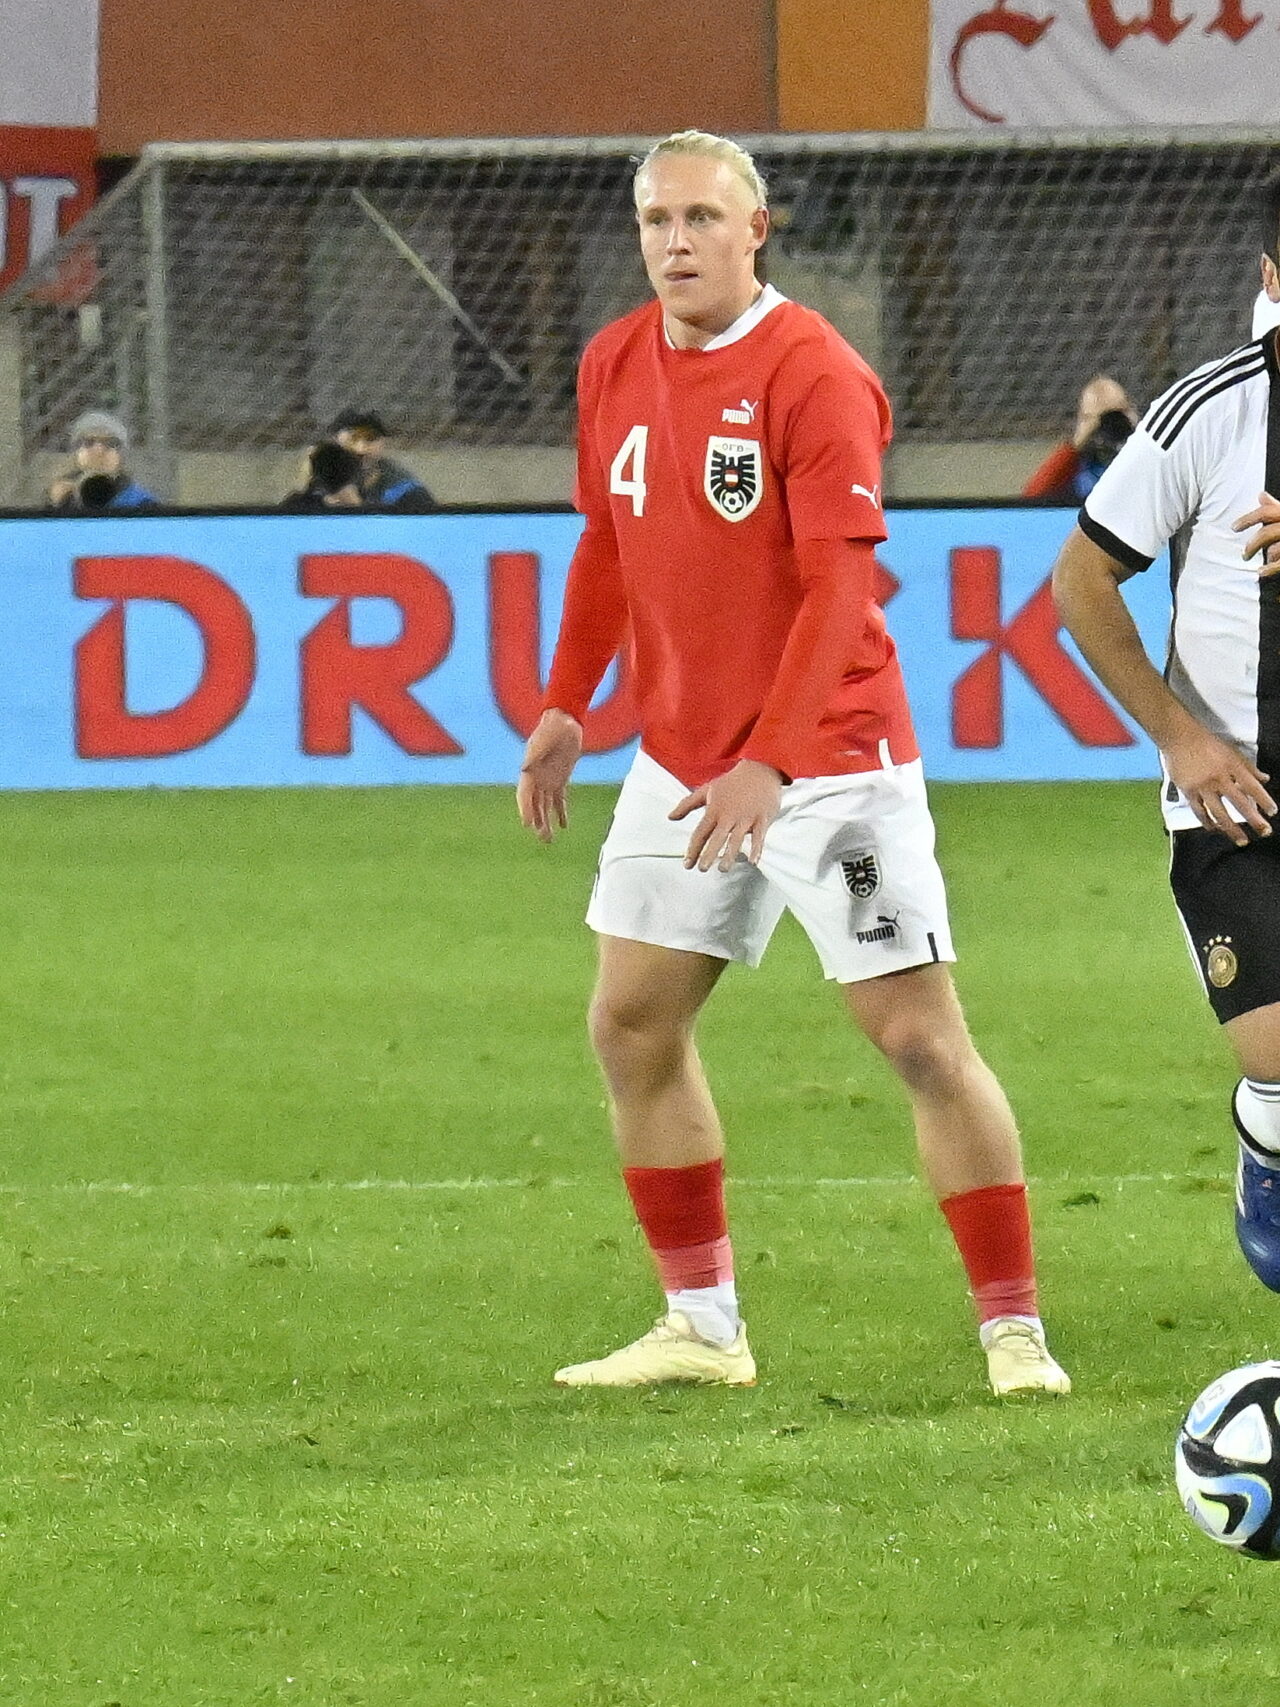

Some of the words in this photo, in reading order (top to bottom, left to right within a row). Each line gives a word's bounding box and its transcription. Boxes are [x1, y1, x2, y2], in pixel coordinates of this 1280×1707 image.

[609, 425, 649, 517] 4
[73, 546, 1136, 759] DRUK
[856, 924, 895, 944] PUMA
